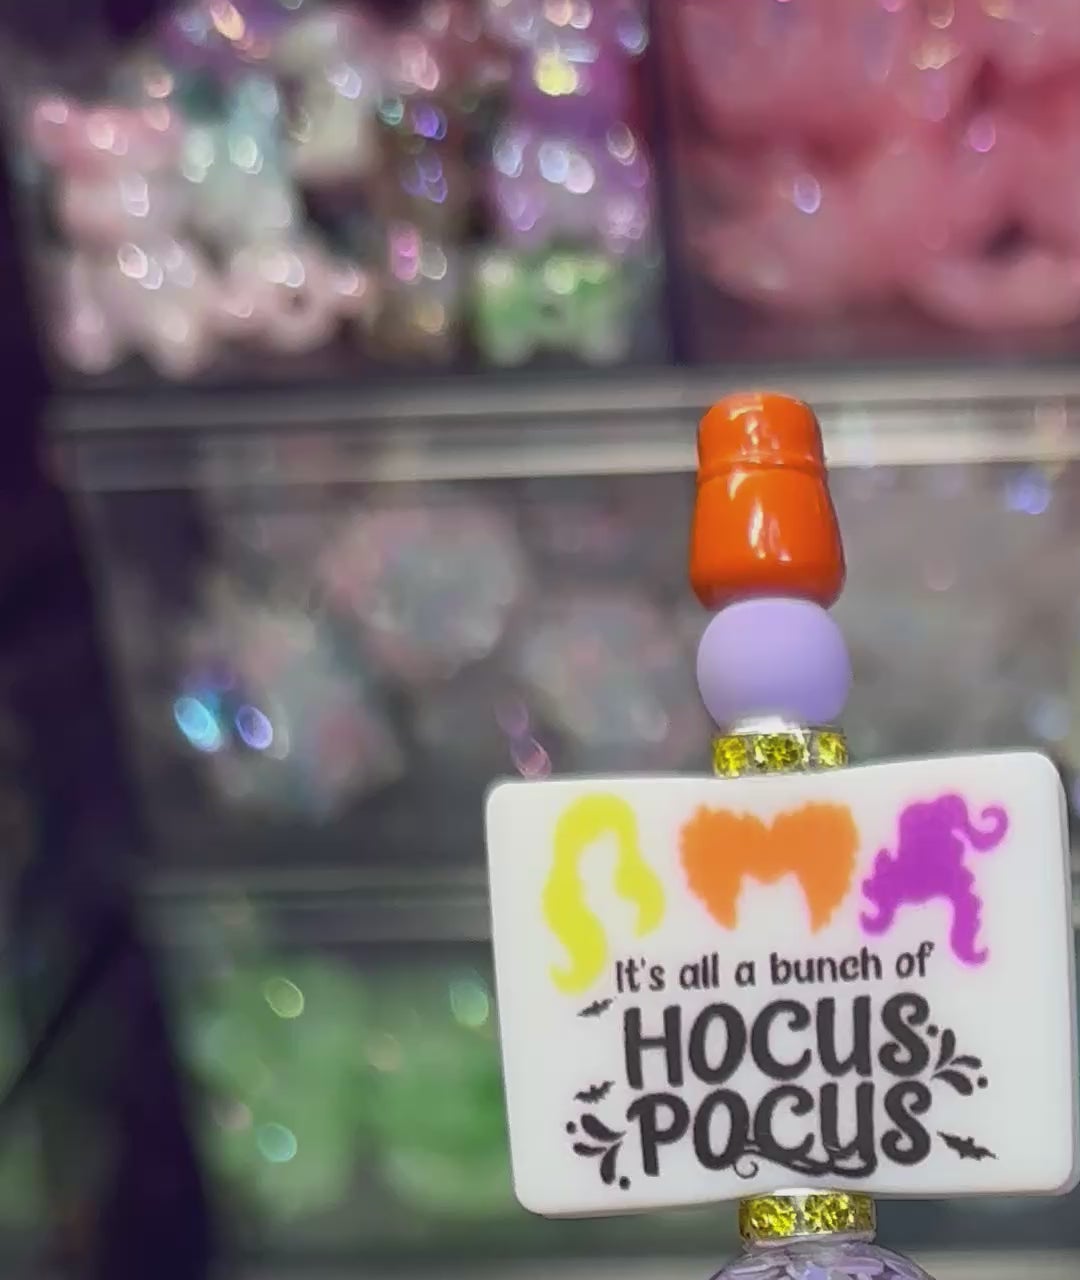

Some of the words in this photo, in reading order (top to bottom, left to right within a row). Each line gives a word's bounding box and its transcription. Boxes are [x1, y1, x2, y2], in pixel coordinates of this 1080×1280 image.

[615, 957, 666, 993] It's
[679, 953, 721, 990] all
[734, 961, 757, 986] a
[769, 946, 883, 986] bunch
[895, 941, 935, 980] of
[623, 991, 931, 1091] HOCUS
[625, 1079, 933, 1179] POCUS
